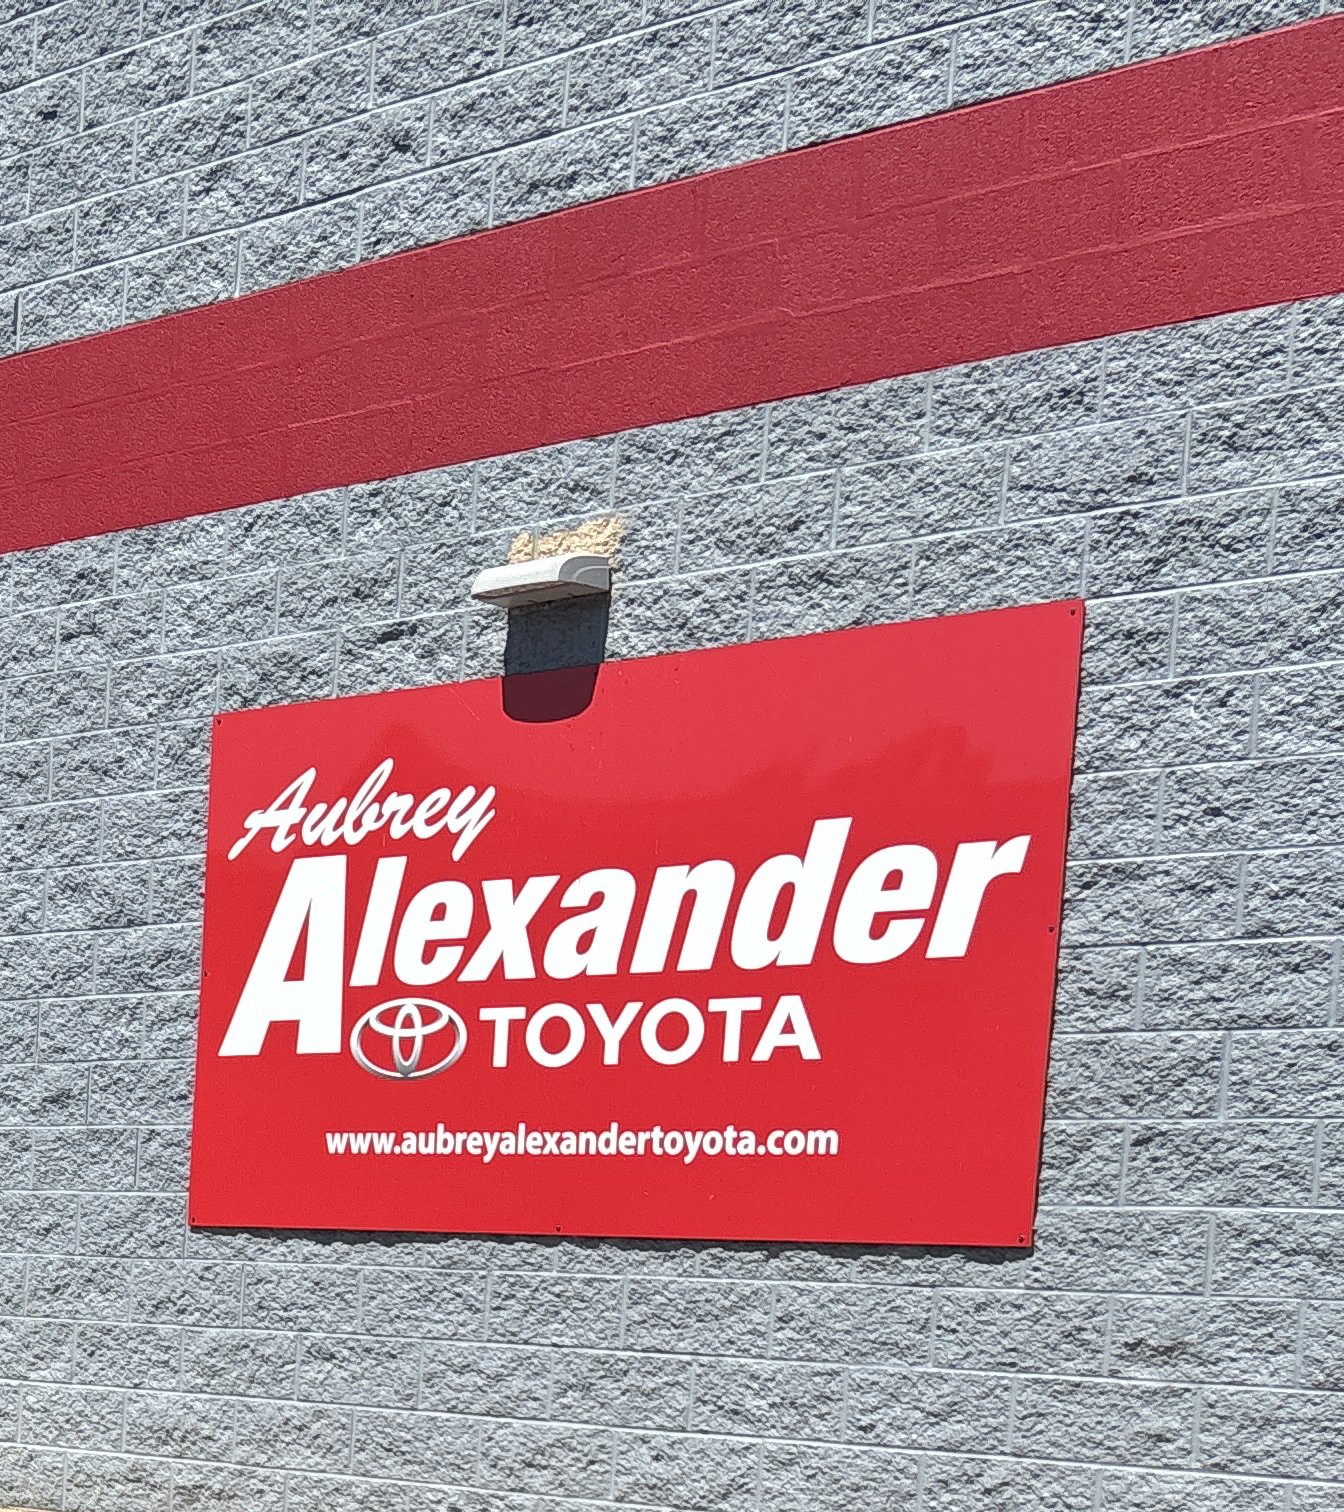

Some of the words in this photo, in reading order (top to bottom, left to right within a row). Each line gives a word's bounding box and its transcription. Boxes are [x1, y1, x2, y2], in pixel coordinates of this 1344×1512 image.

[227, 757, 496, 862] Aubrey
[217, 816, 1032, 1057] Alexander
[479, 995, 822, 1068] TOYOTA
[325, 1121, 840, 1165] www.aubreyalexandertoyota.com
